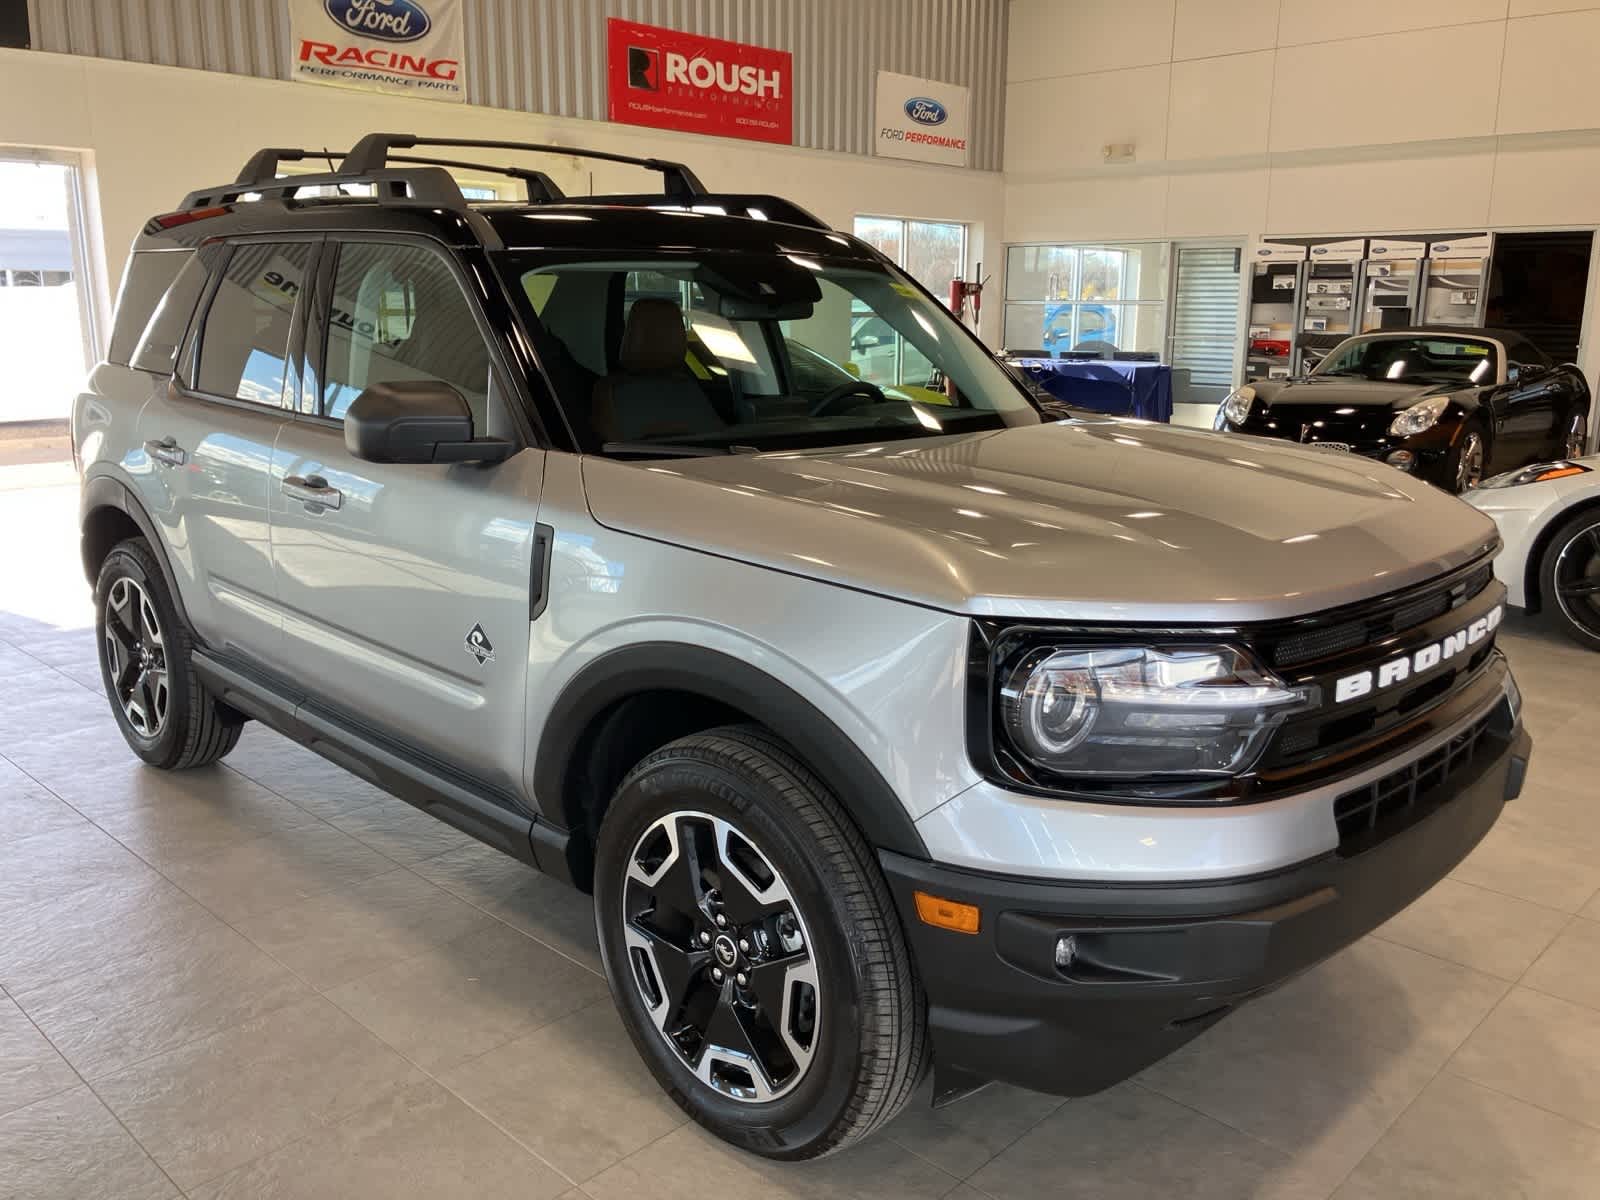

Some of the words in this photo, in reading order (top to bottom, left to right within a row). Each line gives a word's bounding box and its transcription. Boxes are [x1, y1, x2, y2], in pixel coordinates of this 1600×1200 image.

[346, 0, 411, 35] Ford
[299, 40, 459, 81] RACING
[665, 52, 781, 99] ROUSH
[300, 65, 414, 87] PERFORMANCE
[417, 81, 459, 92] PARTS
[912, 101, 940, 121] Ford
[880, 128, 904, 141] FORD
[904, 131, 966, 150] PERFORMANCE
[1335, 605, 1503, 703] BRONCO
